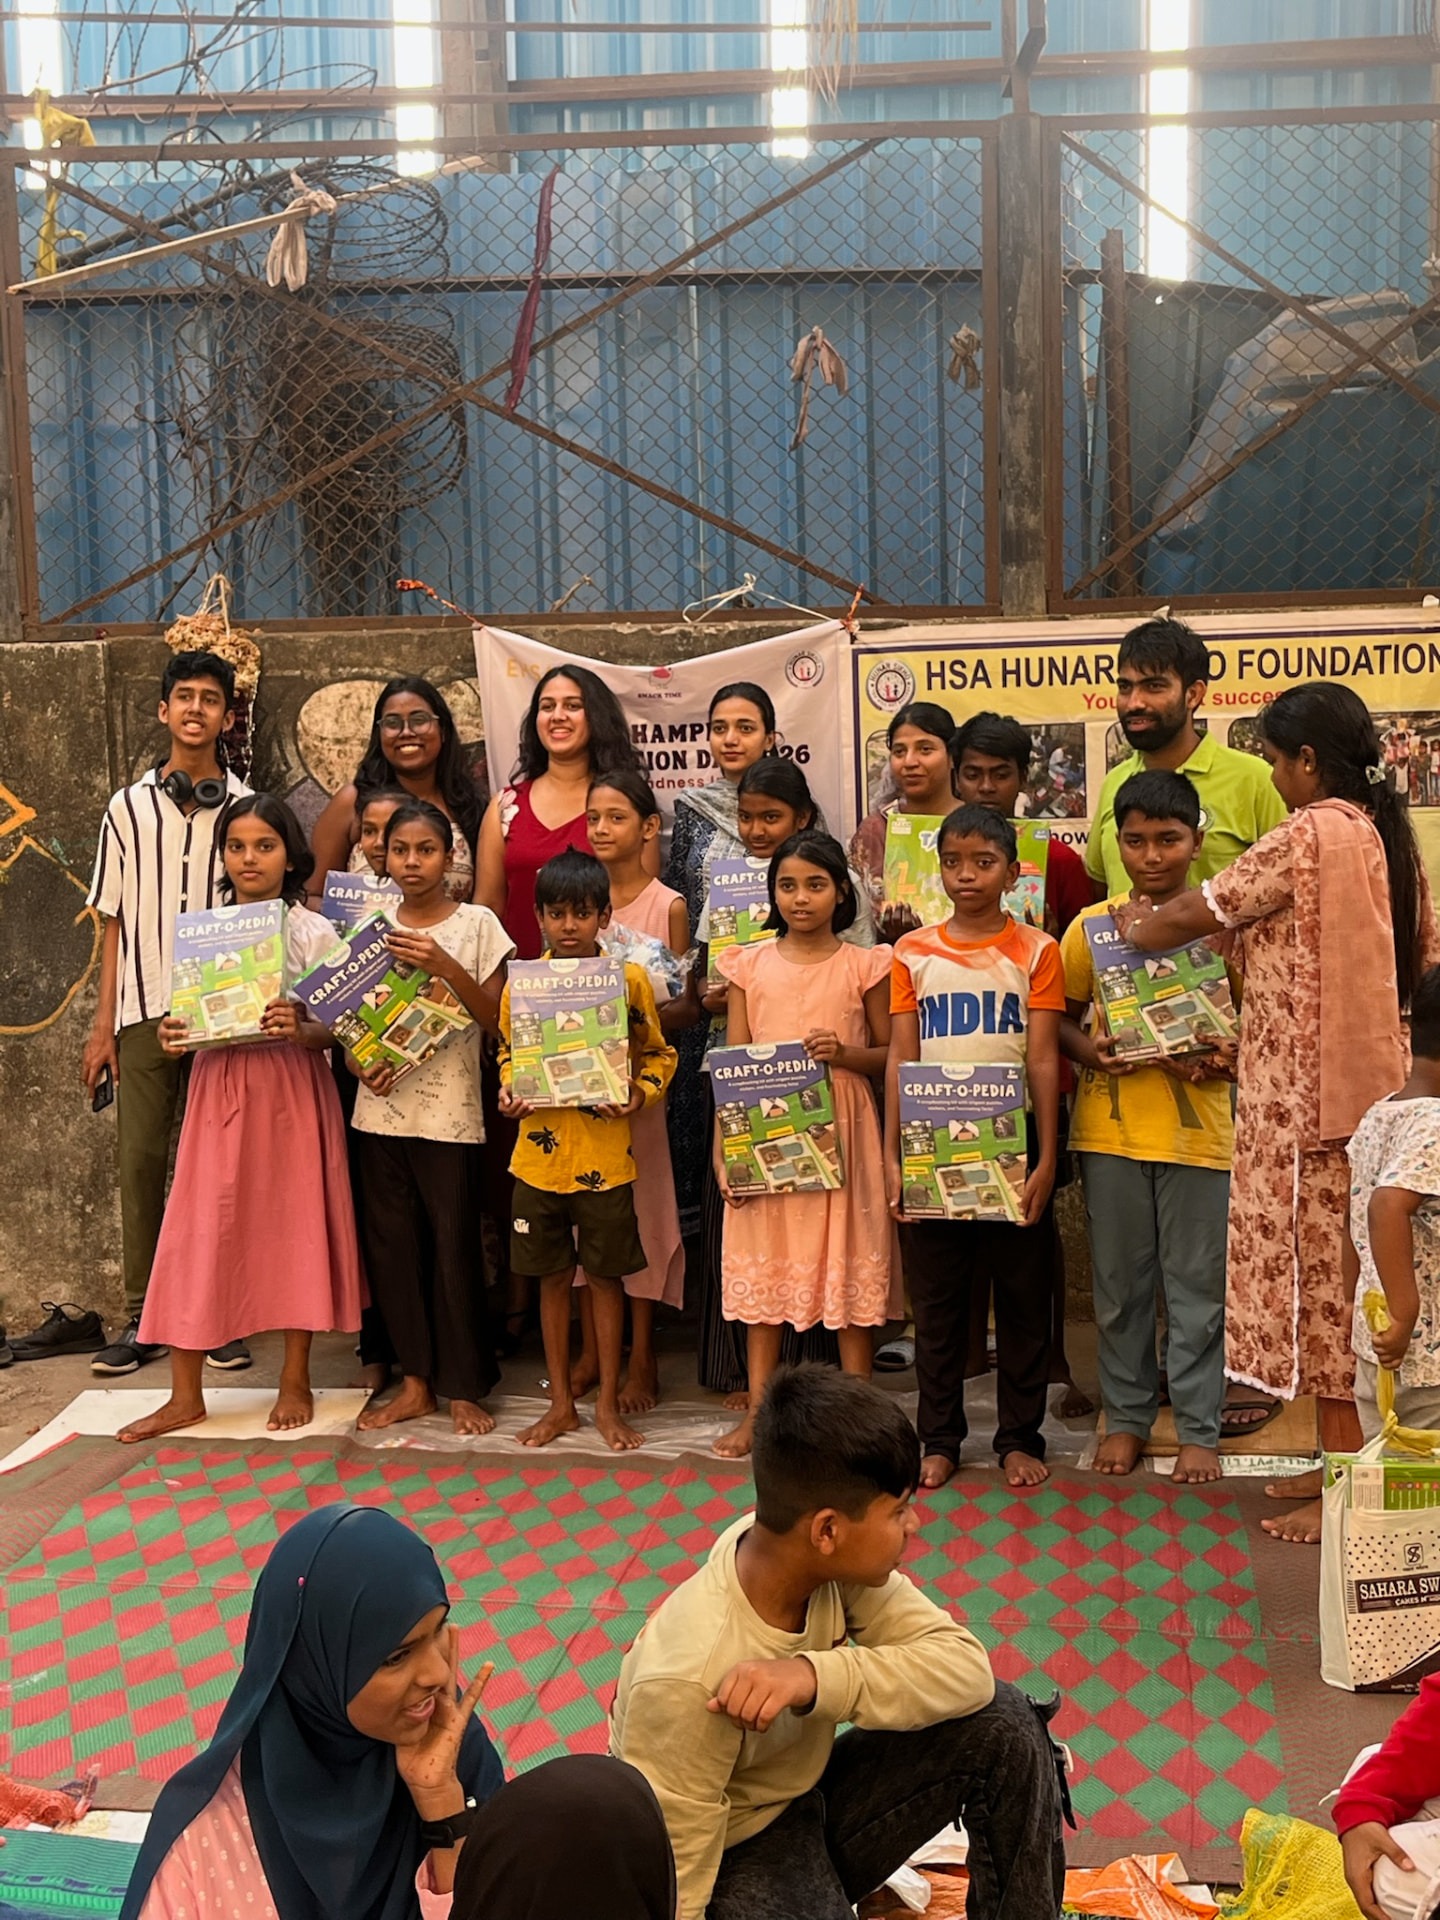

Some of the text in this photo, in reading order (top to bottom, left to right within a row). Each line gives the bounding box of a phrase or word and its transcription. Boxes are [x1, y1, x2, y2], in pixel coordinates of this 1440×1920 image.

[926, 659, 992, 690] HSA
[1001, 654, 1116, 689] HUNAR
[1082, 693, 1117, 710] You
[643, 750, 687, 771] ION
[780, 744, 811, 764] 26
[178, 915, 275, 938] CRAFT-O-PEDIA
[513, 974, 618, 991] CRAFT-O-PEDIA
[919, 990, 1024, 1040] INDIA
[714, 1059, 817, 1080] CRAFT-O-PEDIA
[903, 1083, 1016, 1098] CRAFT-O-PEDIA
[1360, 1579, 1417, 1600] SAHARA
[1419, 1577, 1440, 1594] SW
